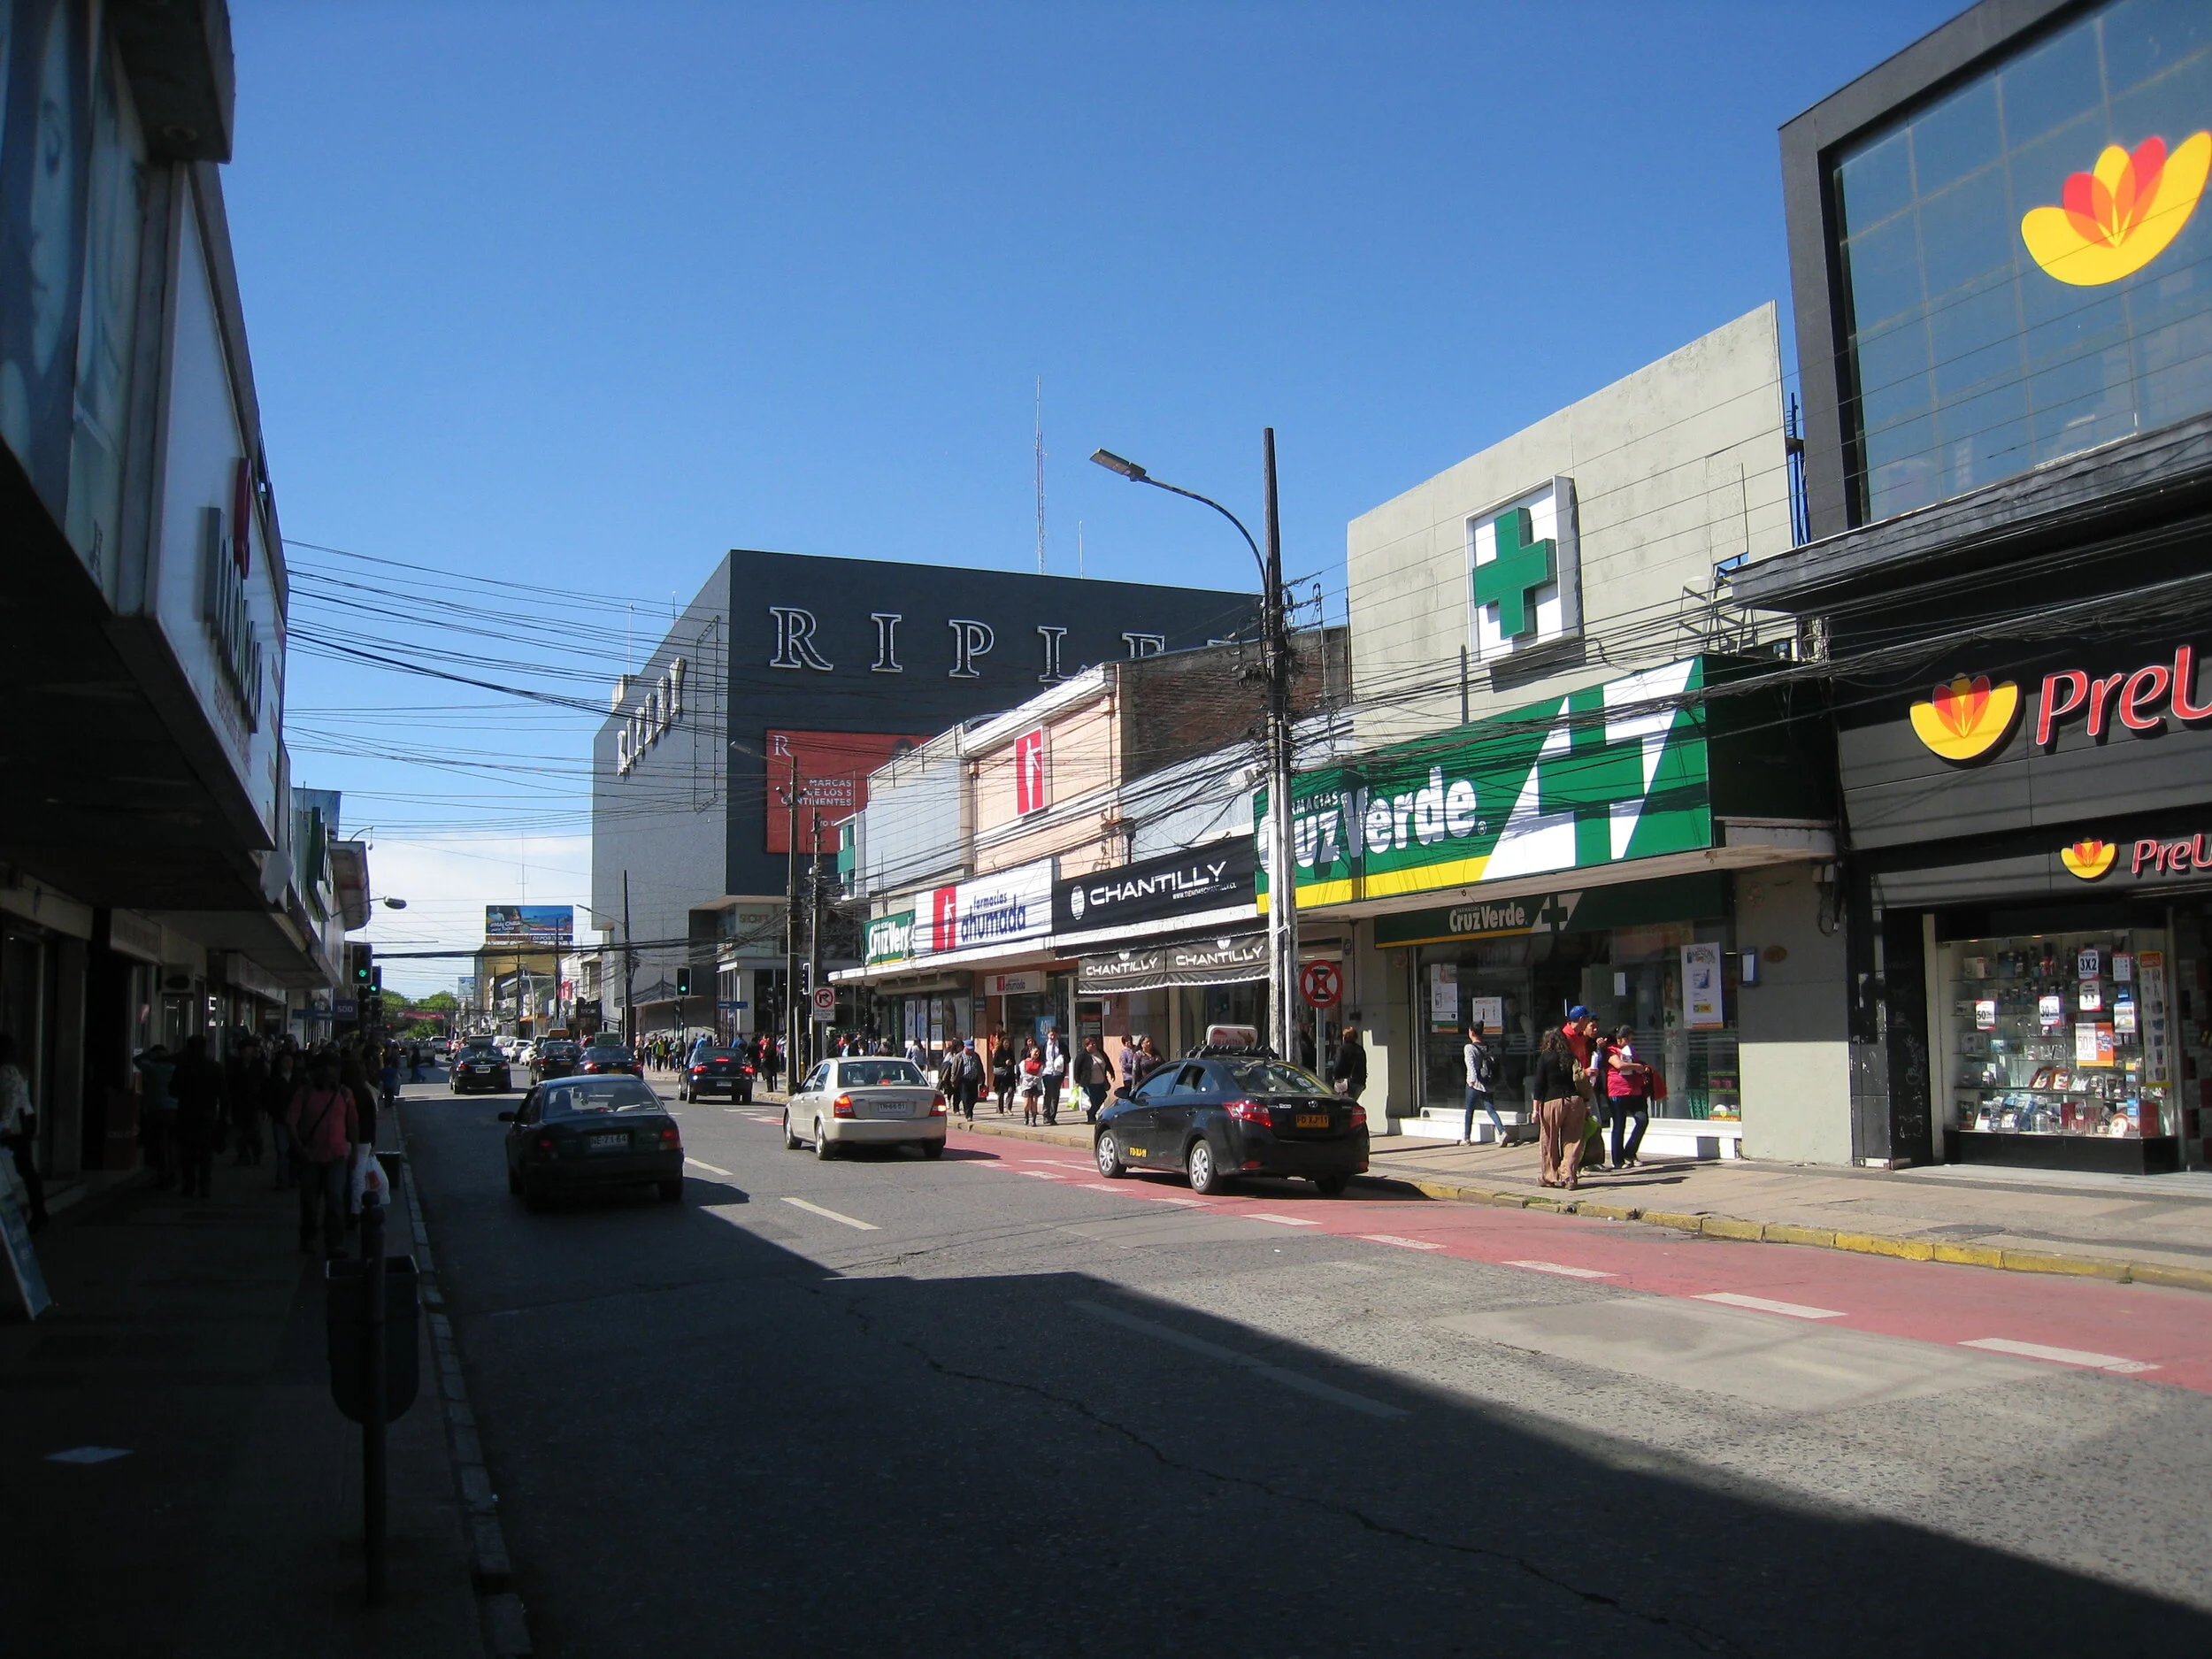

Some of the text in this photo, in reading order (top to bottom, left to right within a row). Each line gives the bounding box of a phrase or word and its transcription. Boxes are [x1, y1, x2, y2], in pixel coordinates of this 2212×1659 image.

[773, 735, 792, 757] R
[809, 779, 852, 787] MARCAS
[781, 797, 852, 807] CNTINENTES
[1090, 861, 1226, 906] CHANTILLY
[973, 889, 1007, 910] farmacias
[961, 894, 1026, 942] ahumada
[1175, 945, 1264, 966] CHANTILLY
[1086, 956, 1158, 977] CHANTILLY
